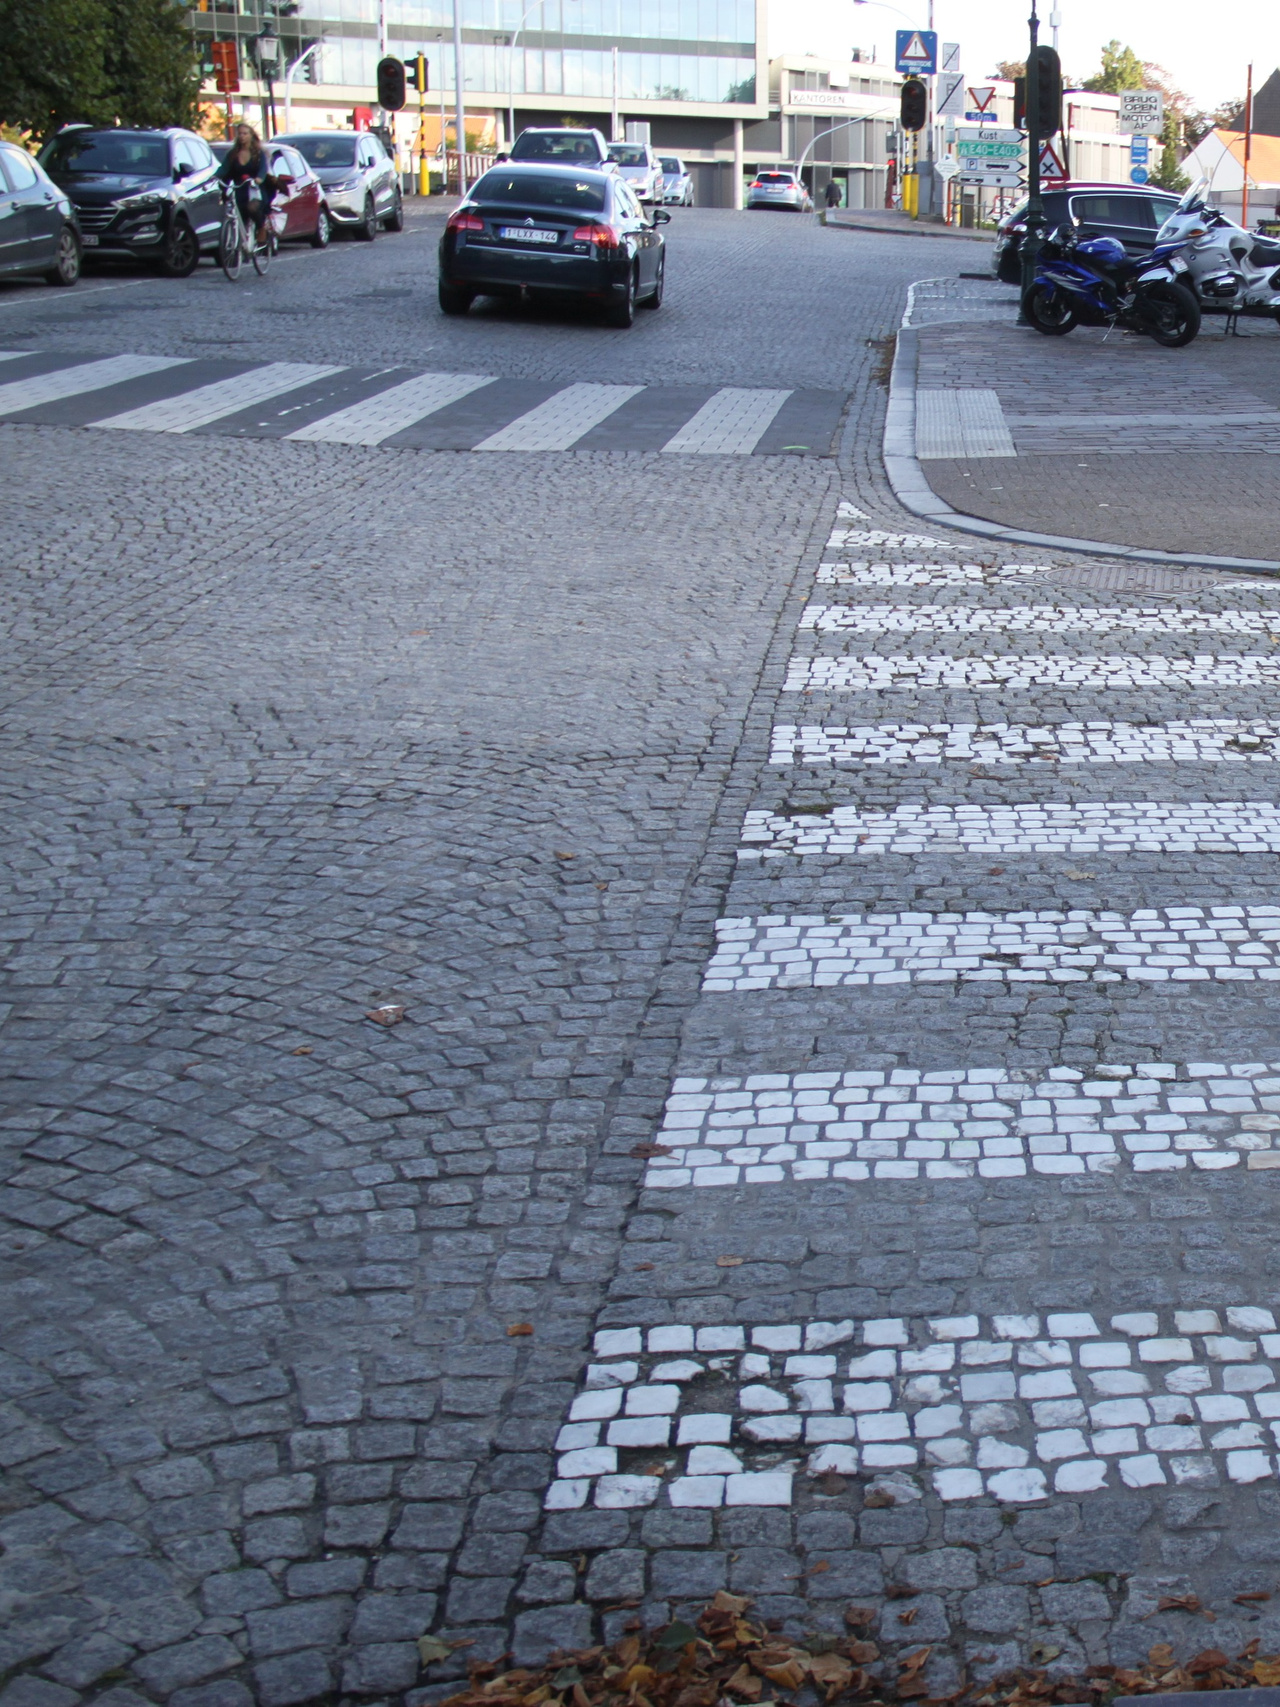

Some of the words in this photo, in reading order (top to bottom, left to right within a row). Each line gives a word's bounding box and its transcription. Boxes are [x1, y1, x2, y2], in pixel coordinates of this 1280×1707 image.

[793, 94, 845, 104] KANTOREN
[970, 113, 993, 121] 50m
[1133, 122, 1149, 130] AF
[978, 130, 998, 140] Kust
[970, 145, 1018, 157] E40-E403
[507, 229, 557, 241] 1-LXX-144
